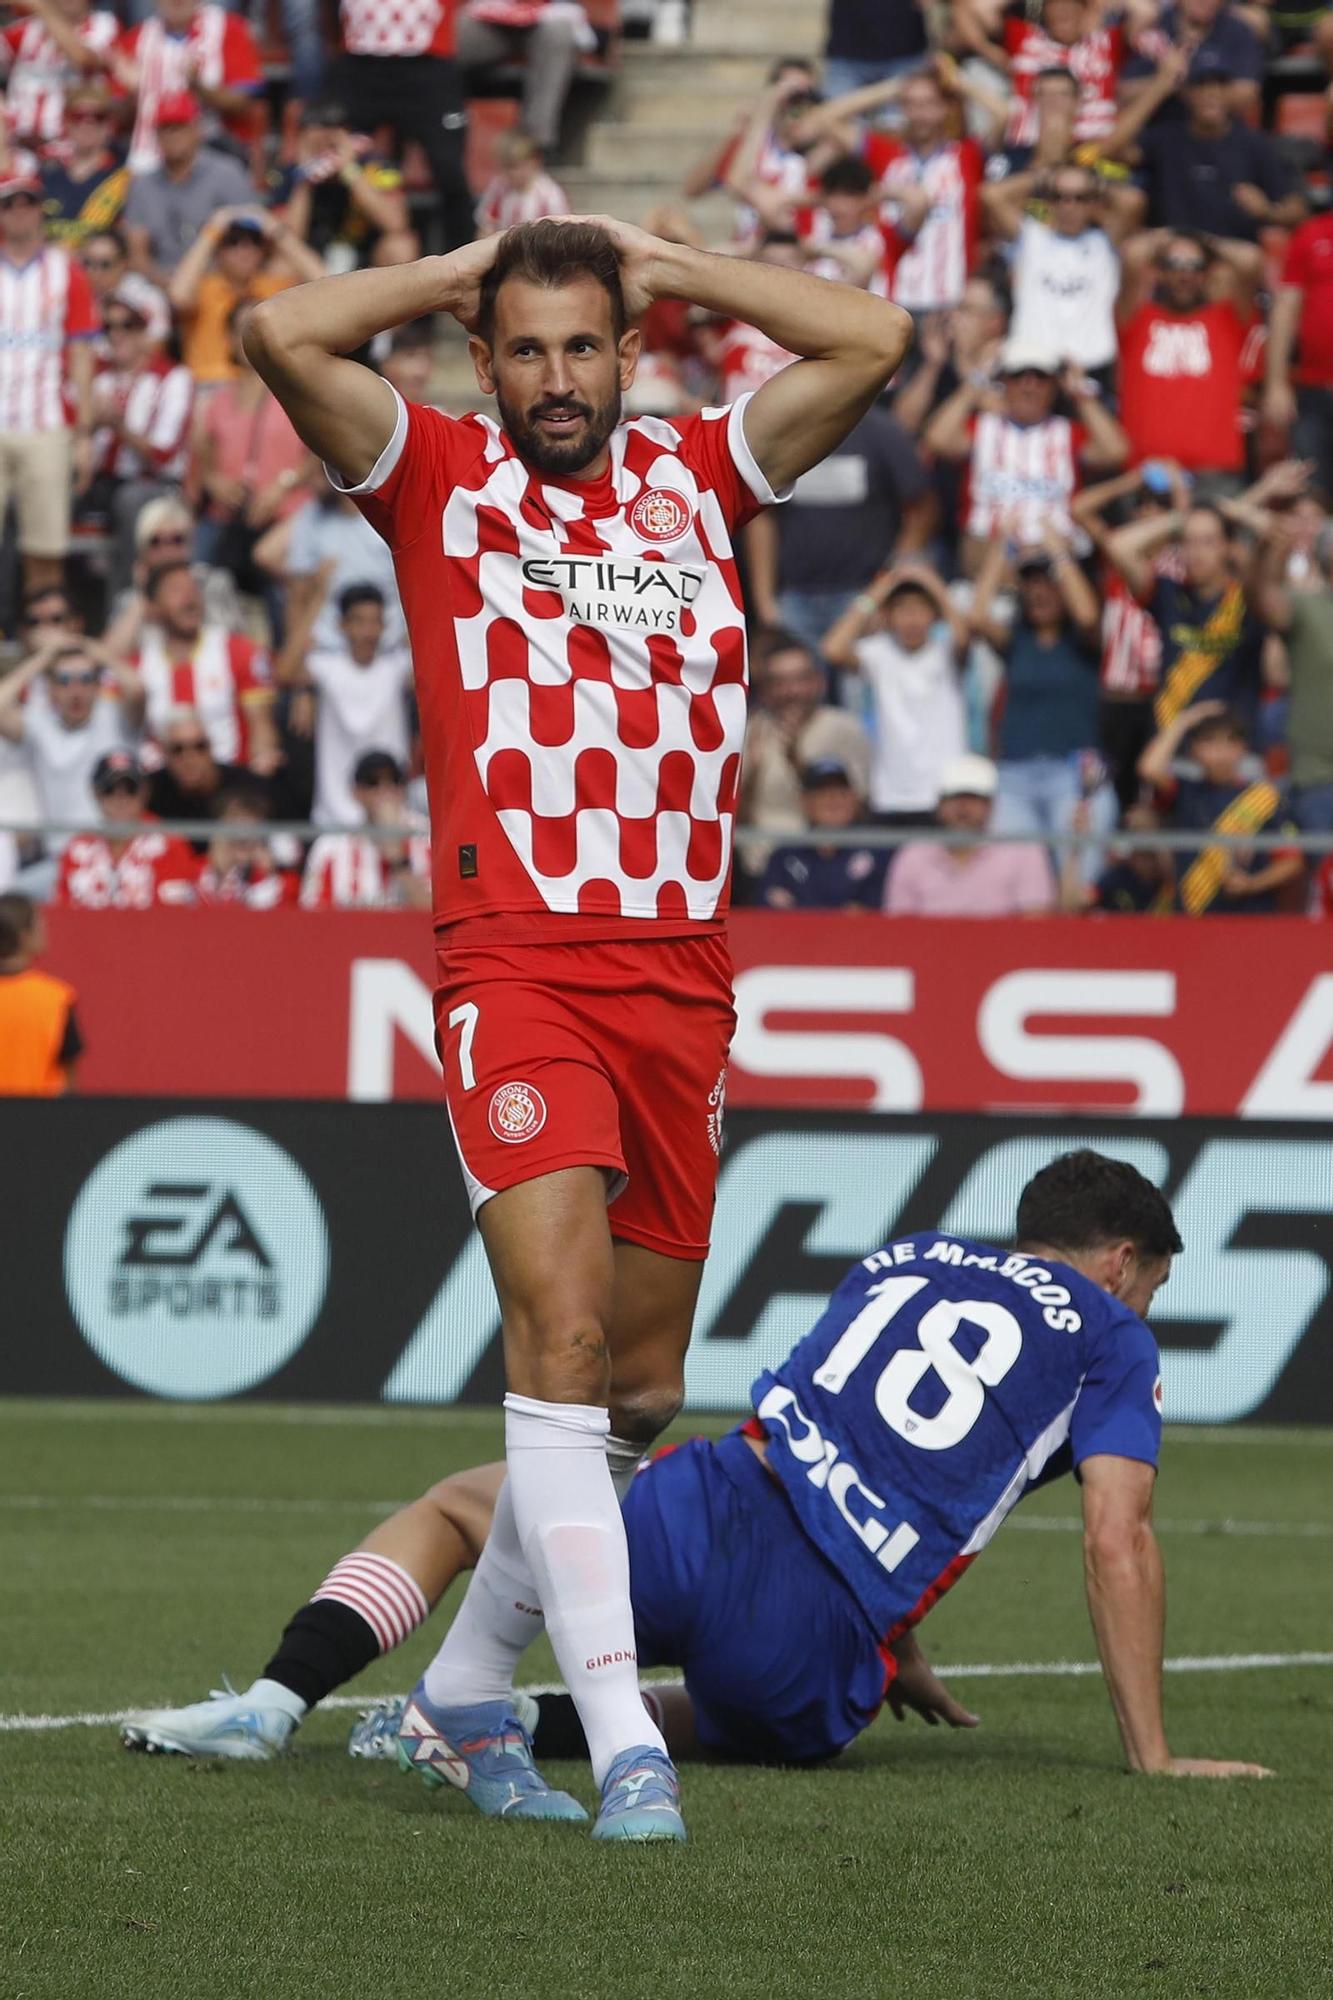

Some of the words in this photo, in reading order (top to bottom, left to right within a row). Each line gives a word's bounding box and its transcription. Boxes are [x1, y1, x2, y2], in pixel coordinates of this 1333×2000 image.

[634, 491, 664, 521] GIRONA
[522, 558, 703, 604] ETIHAD
[568, 601, 677, 630] AIRWAYS
[347, 957, 1333, 1121] NSS
[448, 1001, 480, 1091] 7
[494, 1085, 529, 1107] GIRONA
[120, 1182, 273, 1268] EA
[110, 1277, 281, 1321] SPORTS
[812, 1274, 1024, 1451] 18
[757, 1384, 921, 1574] DIGI
